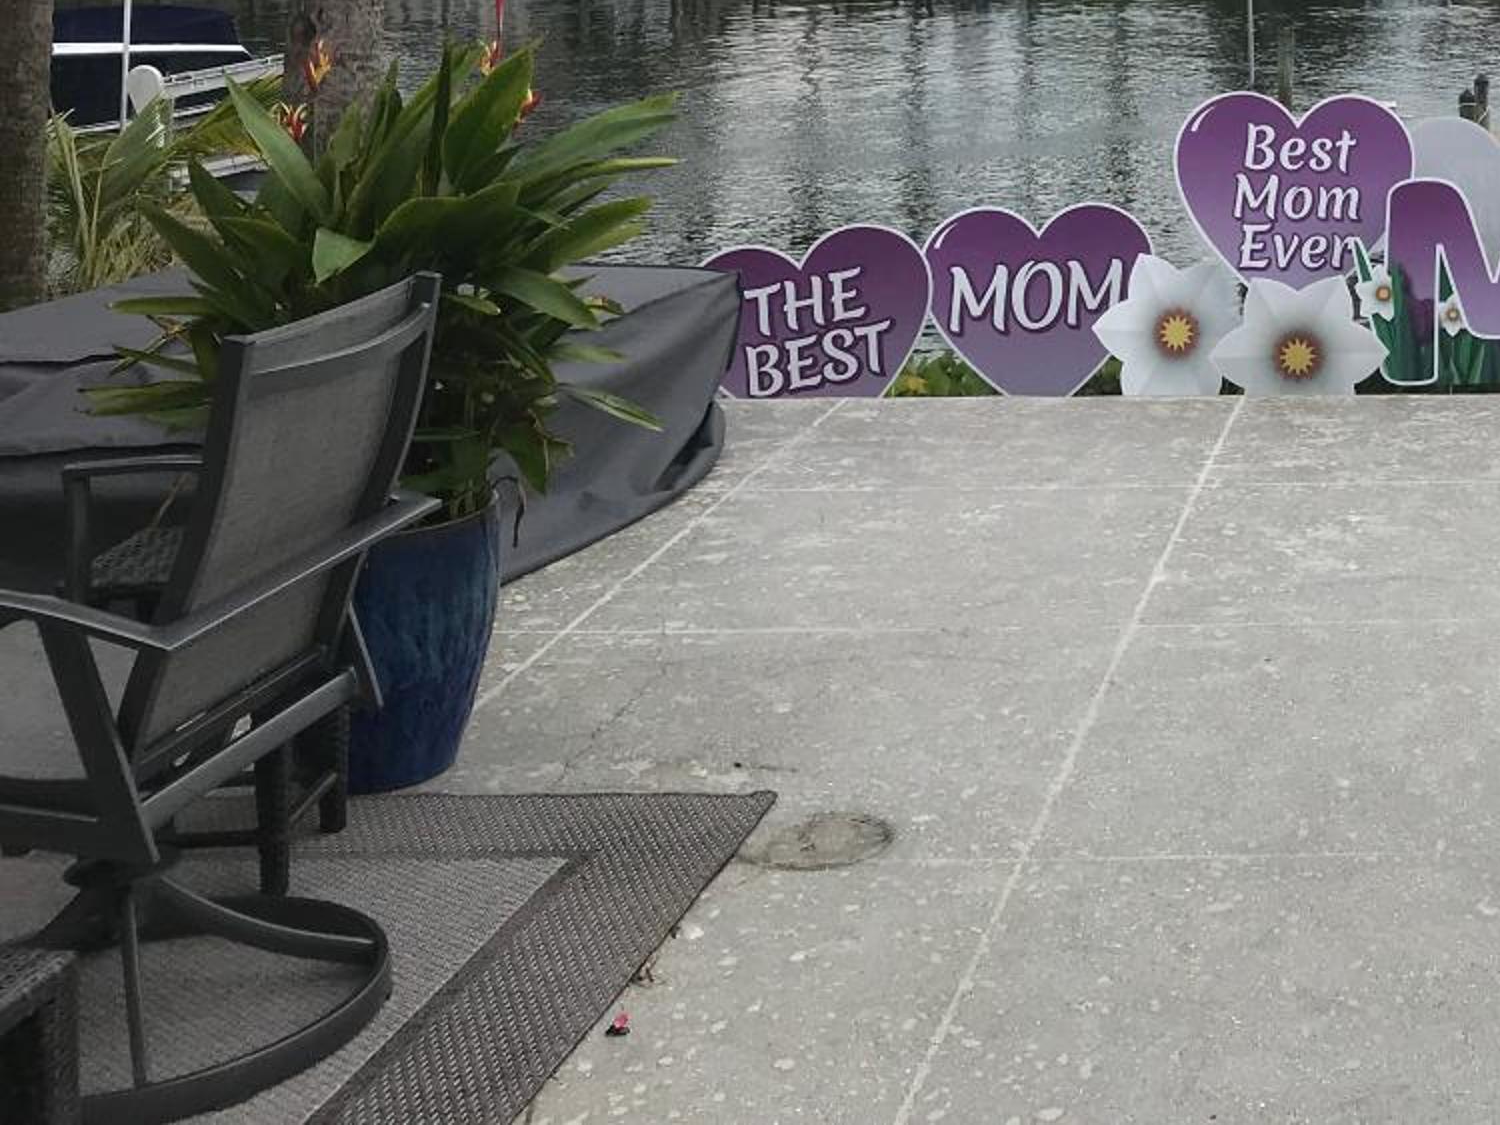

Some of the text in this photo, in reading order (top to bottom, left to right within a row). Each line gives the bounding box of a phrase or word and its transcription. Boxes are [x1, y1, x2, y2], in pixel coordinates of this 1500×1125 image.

[1244, 122, 1356, 173] Best
[1234, 174, 1361, 220] Mom
[1239, 223, 1360, 269] Ever
[744, 266, 868, 338] THE
[948, 258, 1123, 333] MOM
[745, 319, 892, 398] BEST
